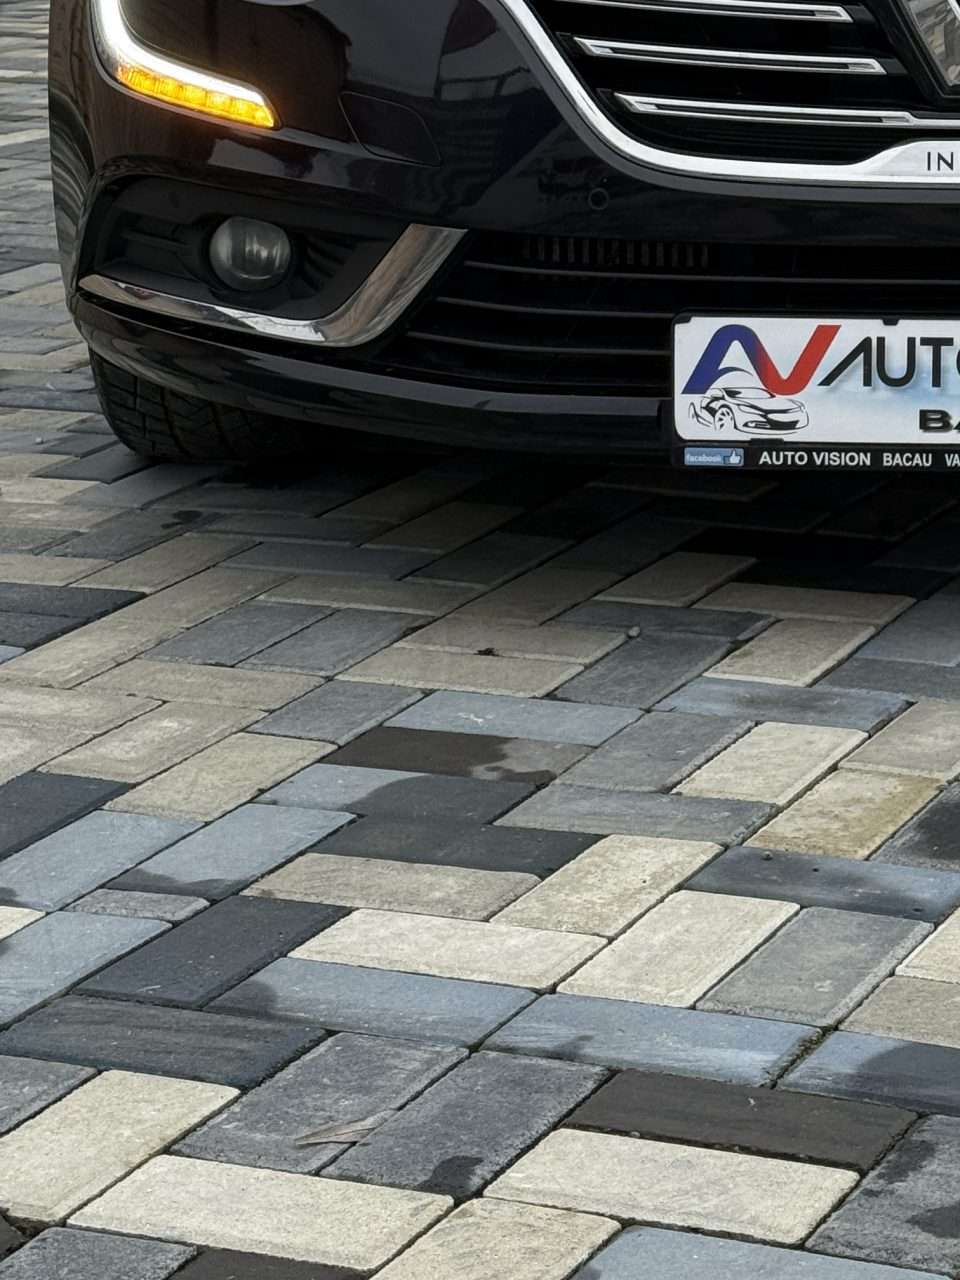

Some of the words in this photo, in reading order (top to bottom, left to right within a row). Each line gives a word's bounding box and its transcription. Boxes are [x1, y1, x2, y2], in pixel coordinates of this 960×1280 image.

[758, 451, 812, 466] AUTO
[813, 452, 872, 466] VISION
[883, 452, 932, 467] BACAU
